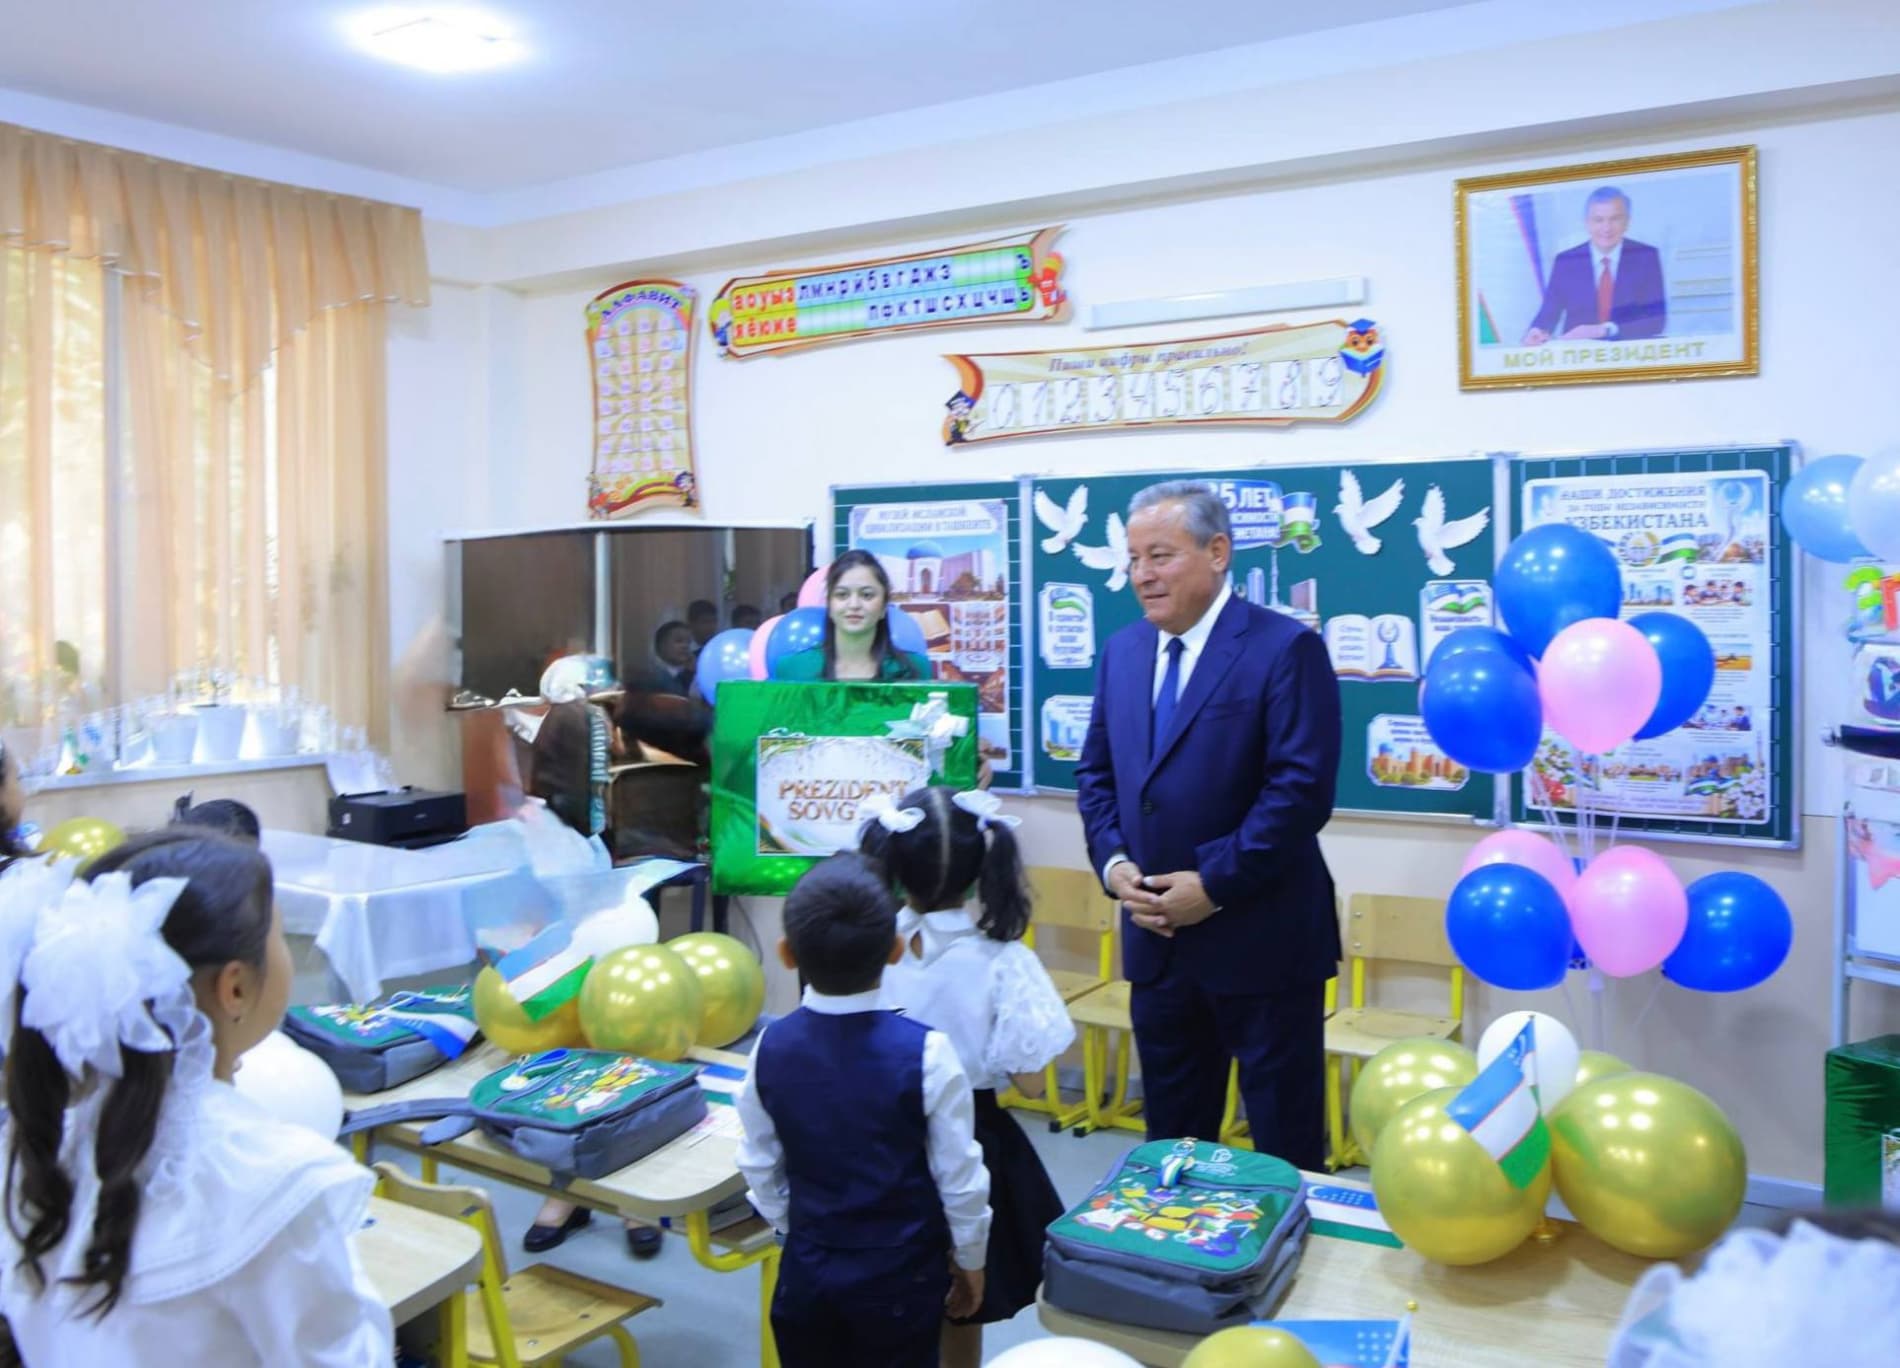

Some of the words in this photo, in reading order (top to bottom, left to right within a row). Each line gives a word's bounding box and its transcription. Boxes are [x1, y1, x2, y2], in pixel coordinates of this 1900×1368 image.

[1504, 349, 1554, 368] МОЙ
[1562, 342, 1705, 364] ПРЕЗИДЕНТ
[992, 383, 1016, 430] 0
[1059, 377, 1081, 423] 2
[1094, 374, 1117, 421] 3
[1128, 372, 1152, 418] 4
[1163, 367, 1186, 417] 5
[1200, 365, 1222, 414] 6
[1236, 363, 1261, 410] 7
[1279, 359, 1301, 409] 8
[1318, 356, 1342, 407] 9
[778, 779, 909, 800] PREZIDENT
